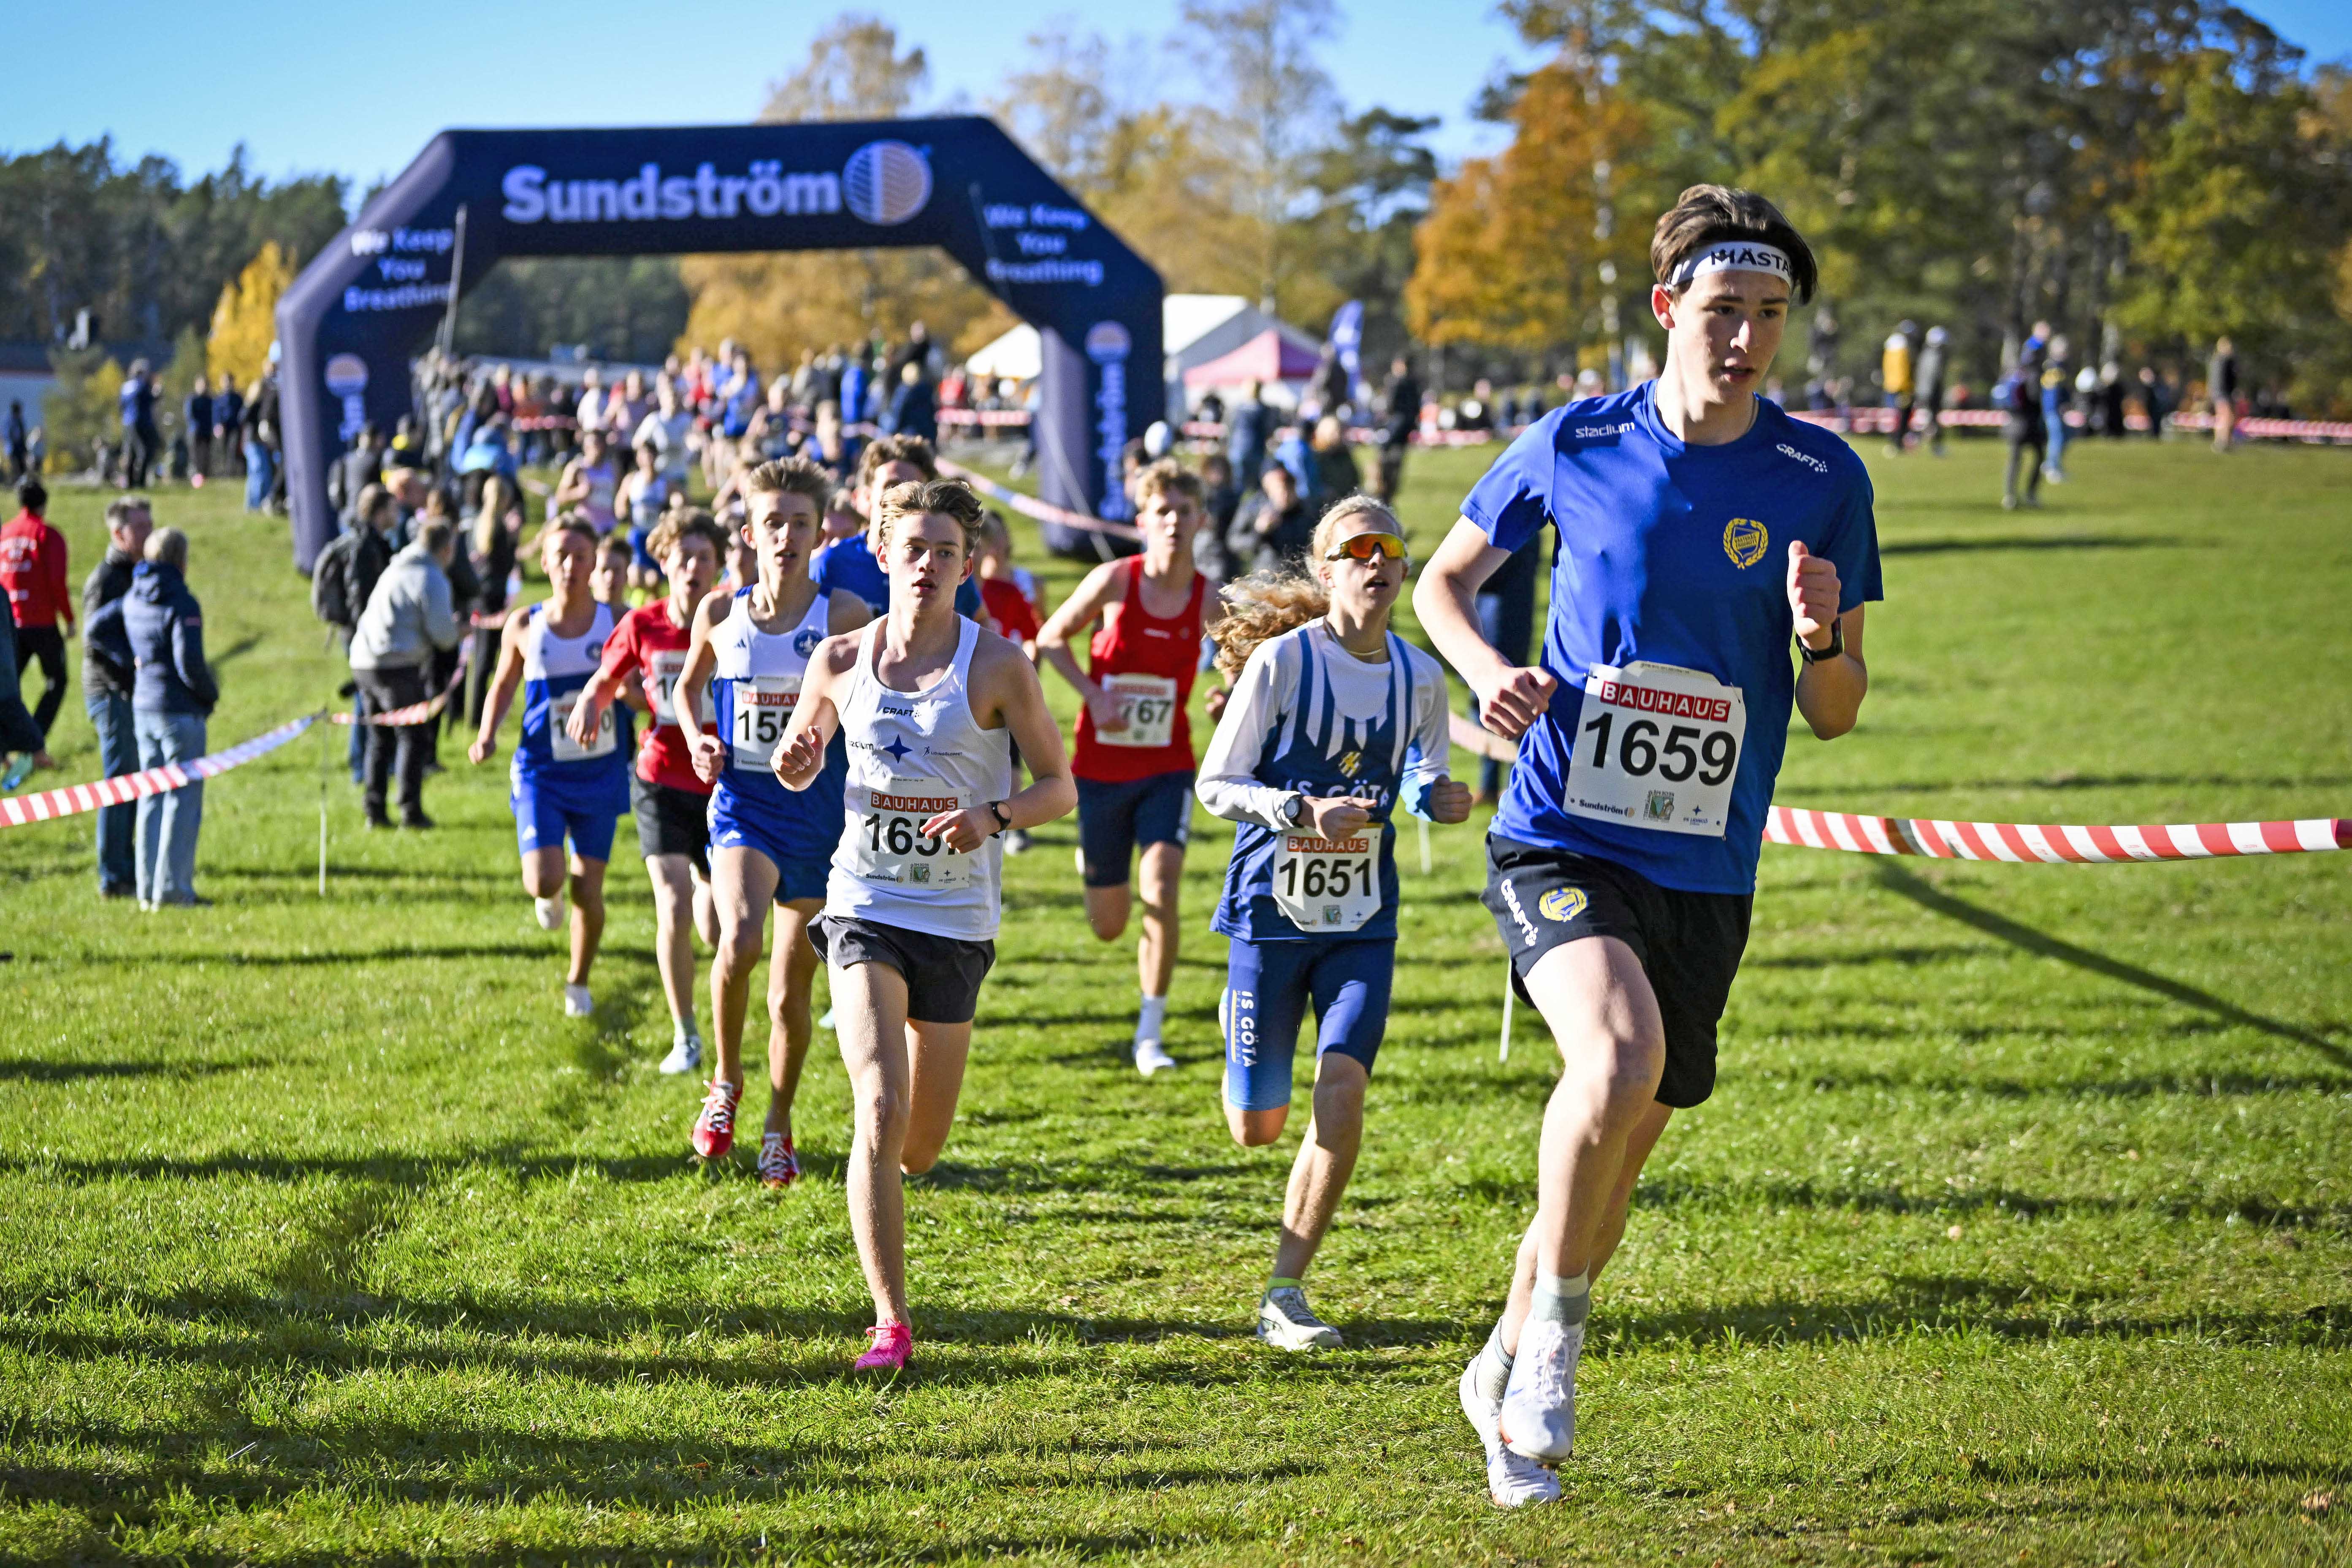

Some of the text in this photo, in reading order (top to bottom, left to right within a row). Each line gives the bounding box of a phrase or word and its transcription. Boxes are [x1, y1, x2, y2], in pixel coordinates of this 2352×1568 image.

[502, 160, 840, 223] Sundström
[379, 256, 425, 281] You
[1710, 248, 1792, 278] MÄSTA
[1575, 422, 1635, 439] stadium
[1776, 444, 1819, 467] CRAFT
[883, 707, 914, 716] CRAFT
[1601, 682, 1729, 720] BAUHAUS
[1585, 712, 1737, 786] 1659
[872, 793, 957, 812] BAUHAUS
[1579, 799, 1623, 815] Sundström
[865, 813, 956, 857] 165
[1288, 837, 1368, 852] BAUHAUS
[865, 873, 895, 882] Sundström
[1279, 858, 1371, 897] 1651
[1501, 878, 1533, 934] CRAFT
[1241, 991, 1260, 1067] IS GÖTA
